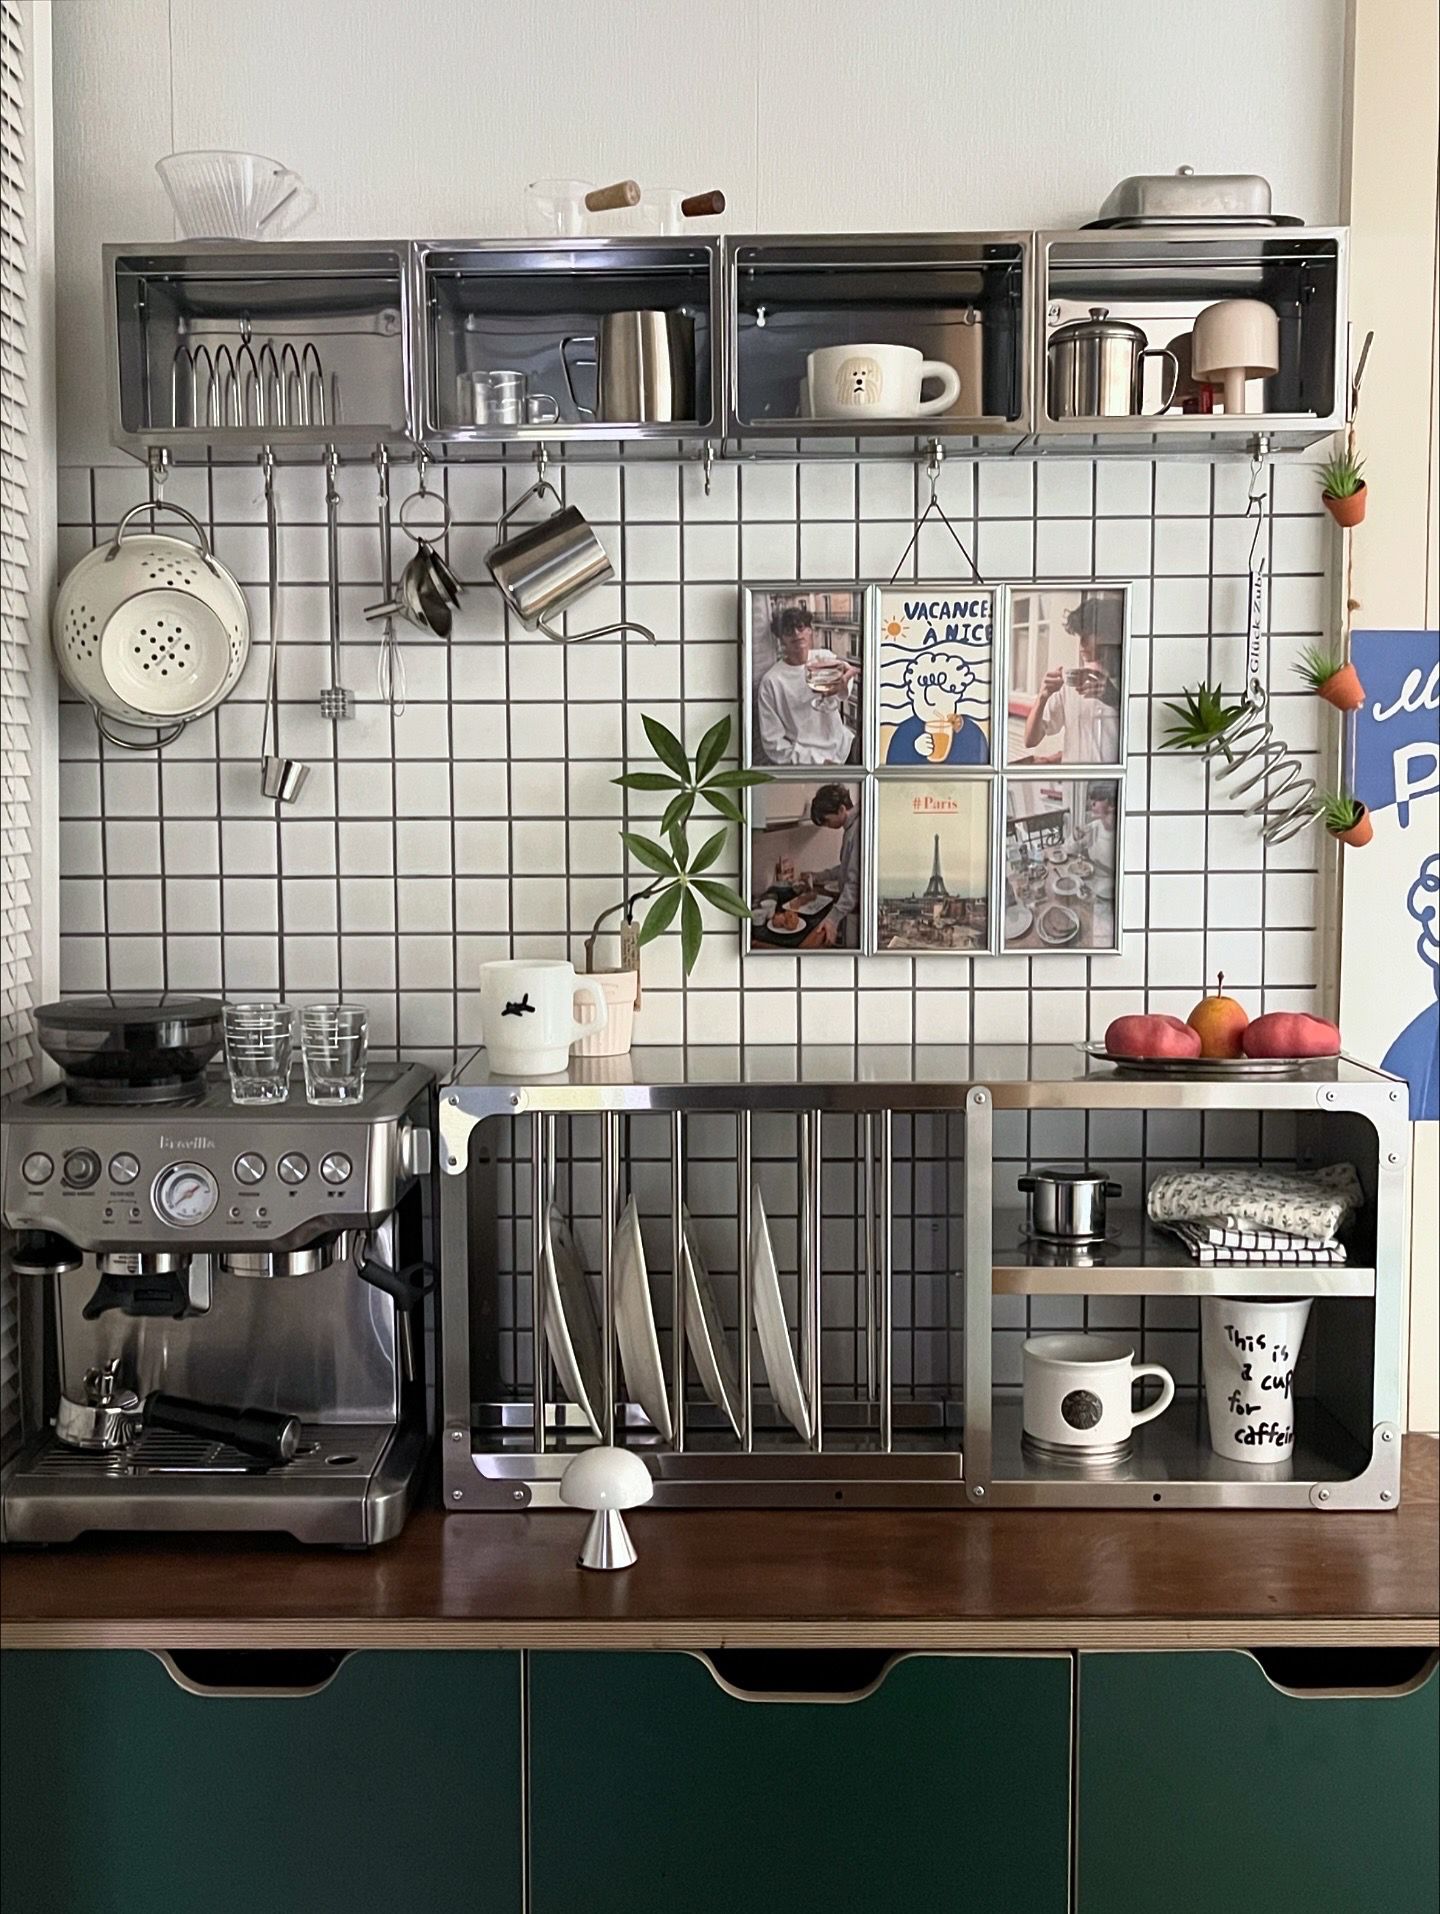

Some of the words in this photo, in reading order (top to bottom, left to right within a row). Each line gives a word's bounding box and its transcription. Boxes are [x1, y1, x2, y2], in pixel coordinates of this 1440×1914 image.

[904, 600, 992, 620] VACANCE
[1250, 619, 1260, 673] Glück
[912, 796, 958, 811] #Paris
[1224, 1325, 1266, 1352] This
[1272, 1345, 1288, 1362] is
[1241, 1363, 1253, 1381] a
[1261, 1369, 1294, 1399] cup
[1228, 1389, 1261, 1415] for
